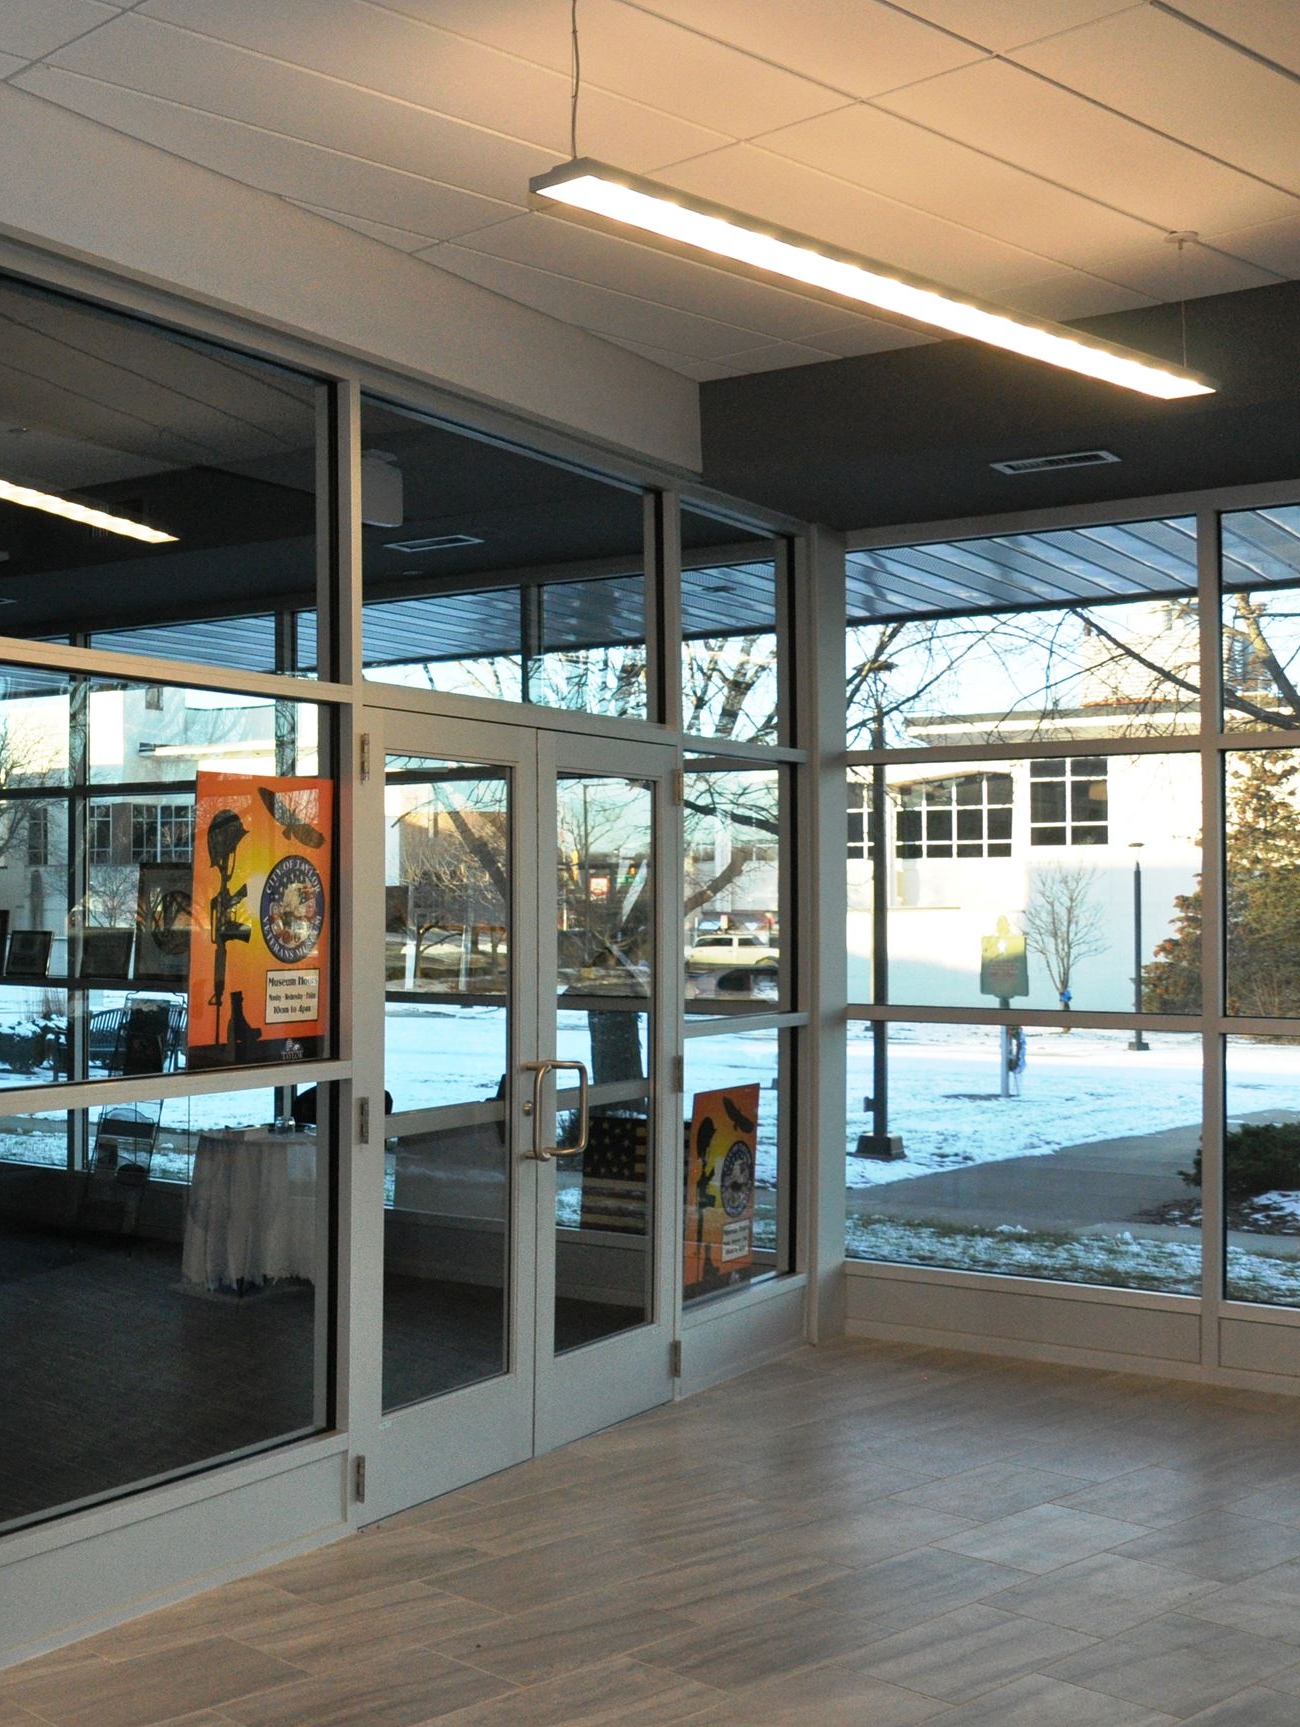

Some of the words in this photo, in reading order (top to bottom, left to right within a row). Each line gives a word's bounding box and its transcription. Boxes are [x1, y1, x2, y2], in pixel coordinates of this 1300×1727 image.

[266, 868, 282, 894] CITY
[283, 860, 293, 870] OF
[296, 860, 321, 893] TAYLOR
[263, 916, 294, 958] VETERANS
[268, 976, 296, 987] Museum
[290, 1005, 297, 1013] to
